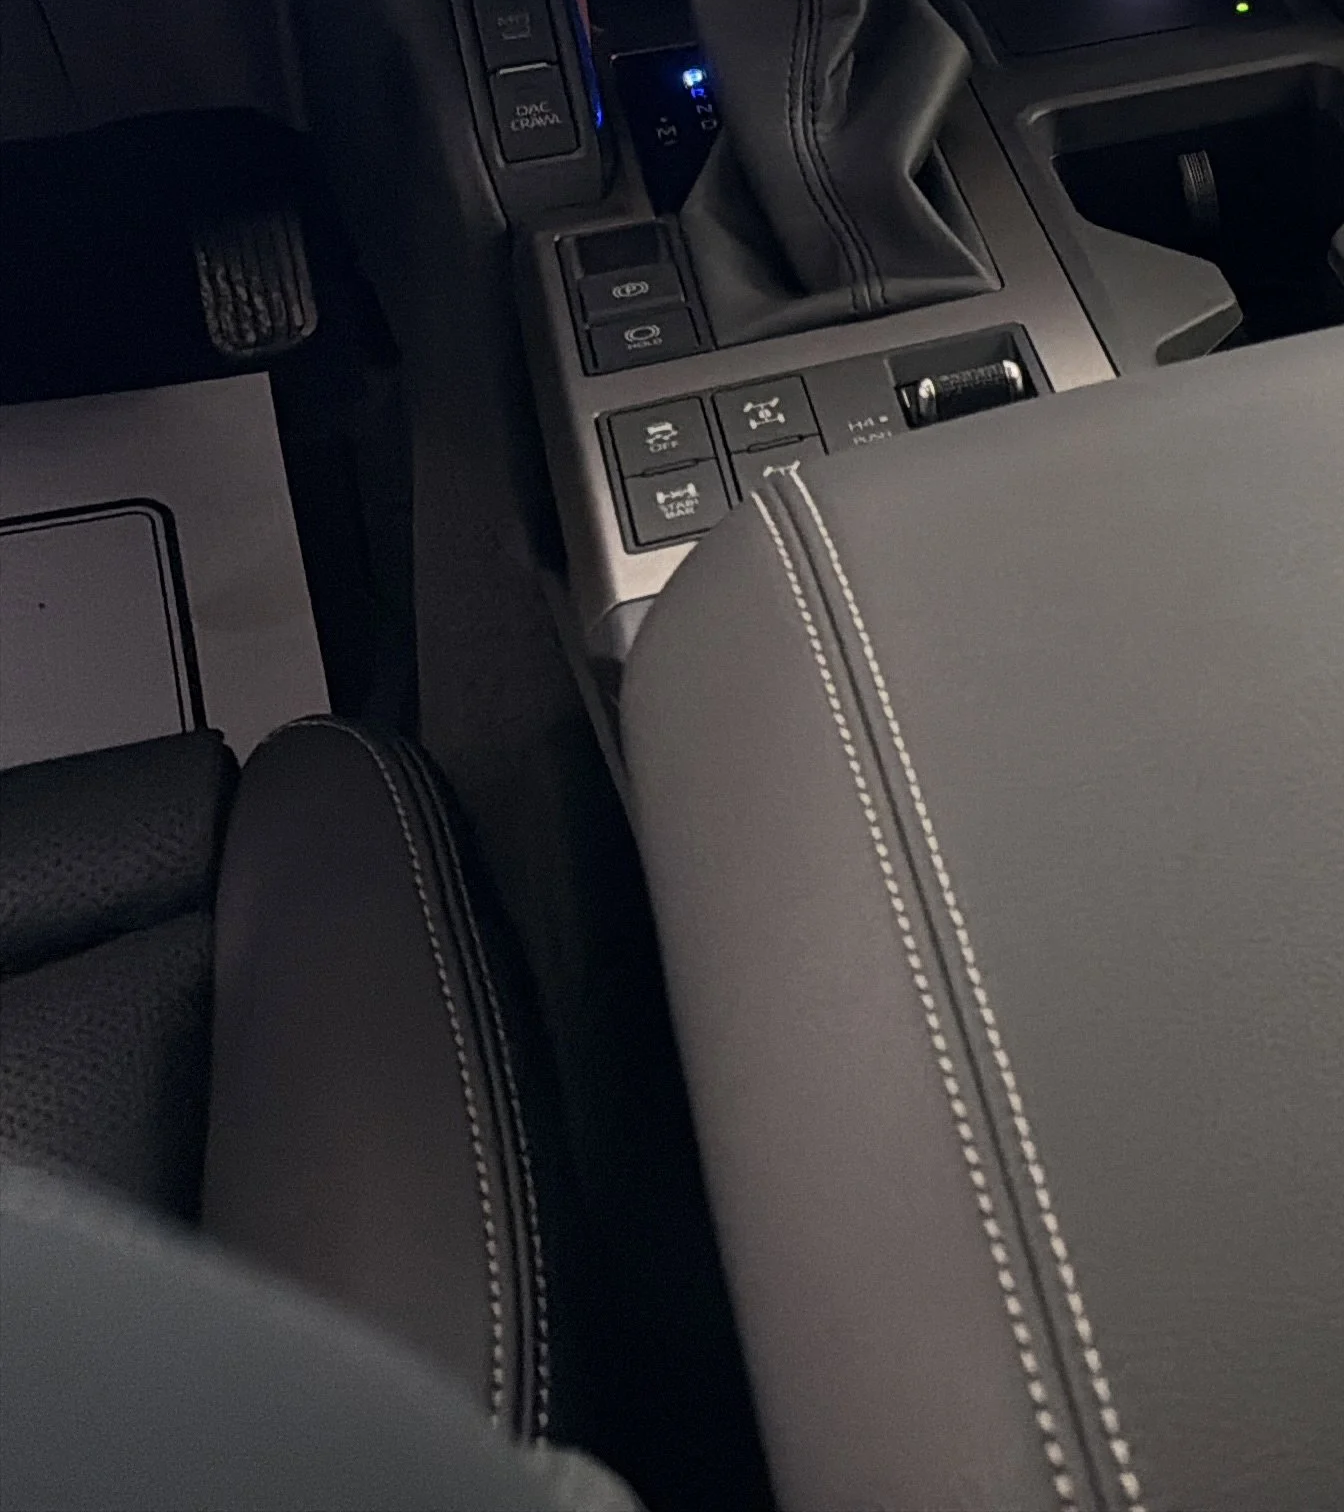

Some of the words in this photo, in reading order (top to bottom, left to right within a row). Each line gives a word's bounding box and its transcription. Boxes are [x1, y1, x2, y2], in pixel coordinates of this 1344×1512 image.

[516, 100, 552, 116] DAC
[696, 103, 713, 115] N
[510, 111, 563, 133] CRAWL
[701, 118, 718, 130] D
[656, 124, 678, 140] M
[627, 337, 663, 351] HOLD
[649, 439, 679, 453] OFF
